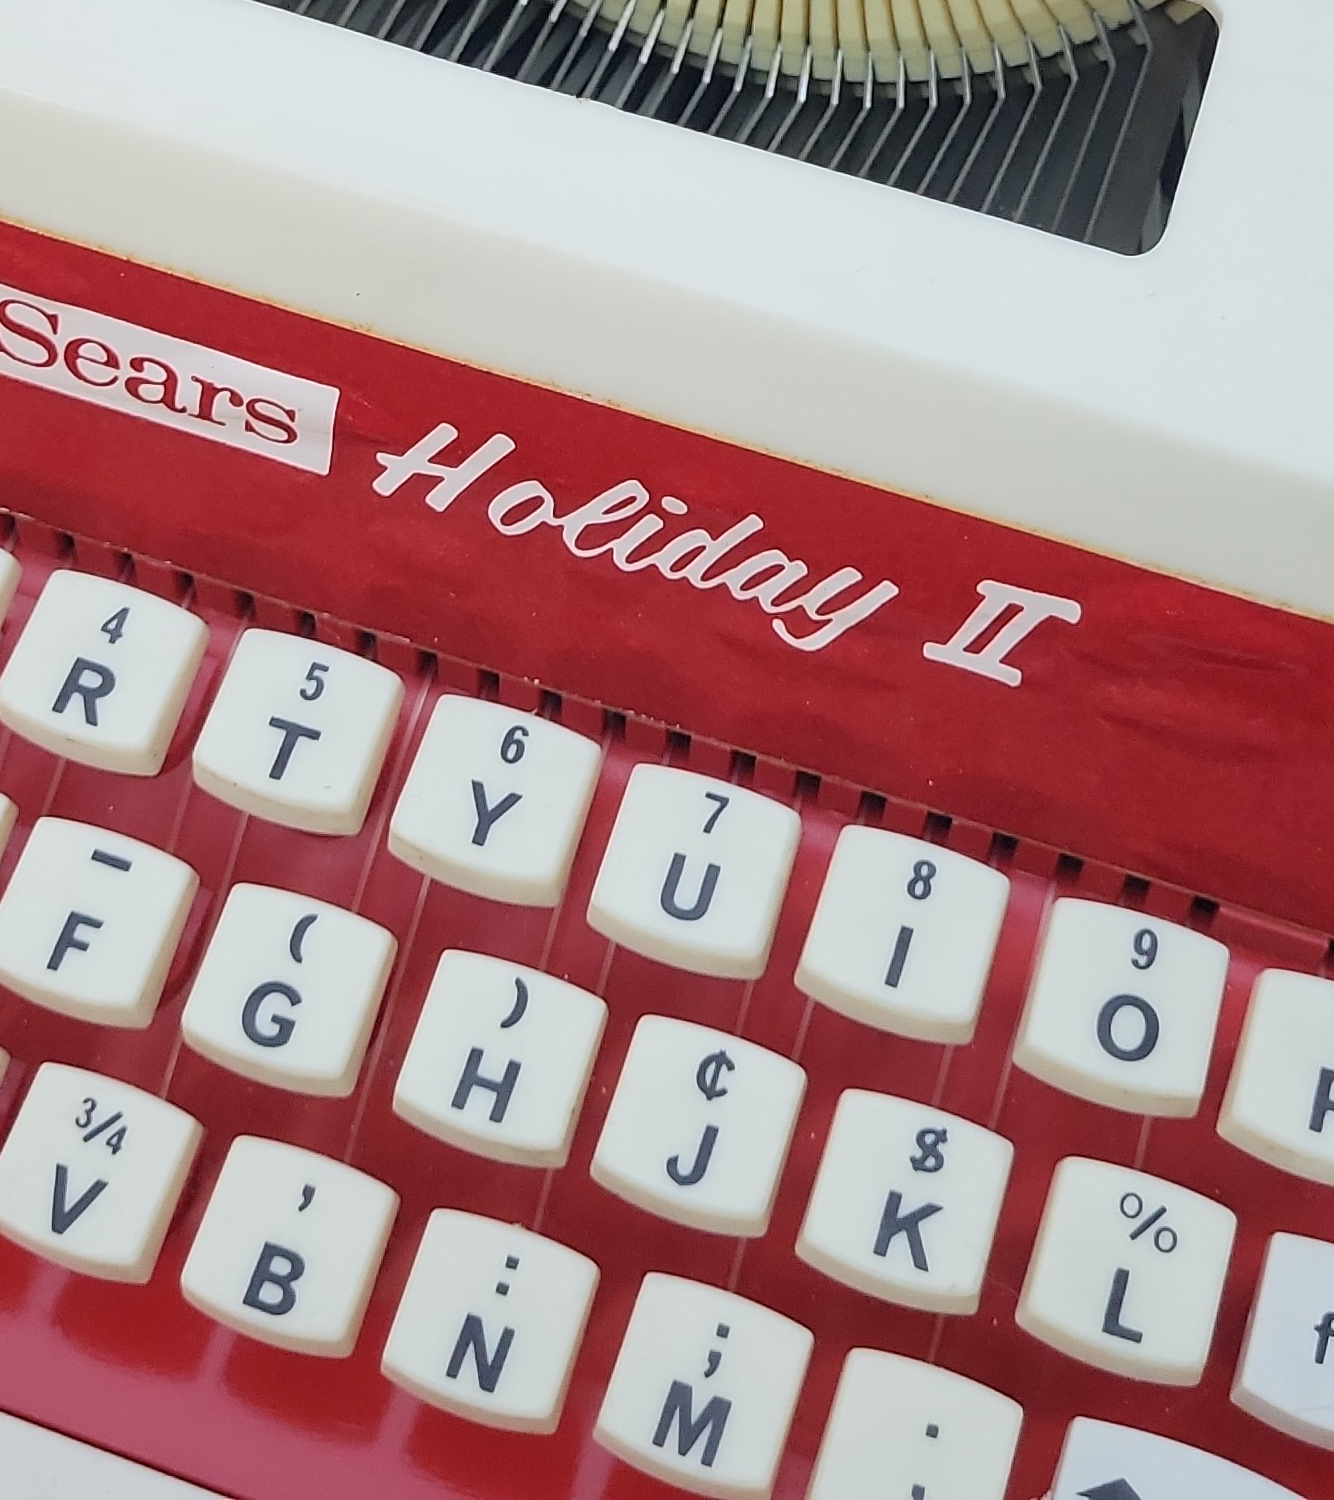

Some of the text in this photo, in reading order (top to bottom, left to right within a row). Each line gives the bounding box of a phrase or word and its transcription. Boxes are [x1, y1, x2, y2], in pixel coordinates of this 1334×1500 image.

[371, 421, 1082, 688] Holiday II
[100, 606, 130, 645] 4
[51, 656, 116, 727] R
[299, 661, 330, 702] 5
[268, 716, 322, 781] T
[500, 725, 530, 765] 6
[471, 779, 523, 847] Y
[702, 791, 730, 835] 7
[660, 852, 721, 922] U
[906, 859, 937, 901] 8
[46, 910, 104, 972] F
[884, 925, 914, 989] I
[1131, 928, 1159, 971] 9
[241, 981, 302, 1049] G
[1096, 993, 1160, 1063] O
[450, 1047, 522, 1124] H
[665, 1124, 720, 1187] J
[50, 1163, 108, 1236] V
[872, 1190, 943, 1273] K
[1119, 1192, 1178, 1254] %
[242, 1241, 305, 1317] B
[1101, 1268, 1143, 1344] L
[445, 1313, 515, 1394] N
[651, 1380, 732, 1468] M
